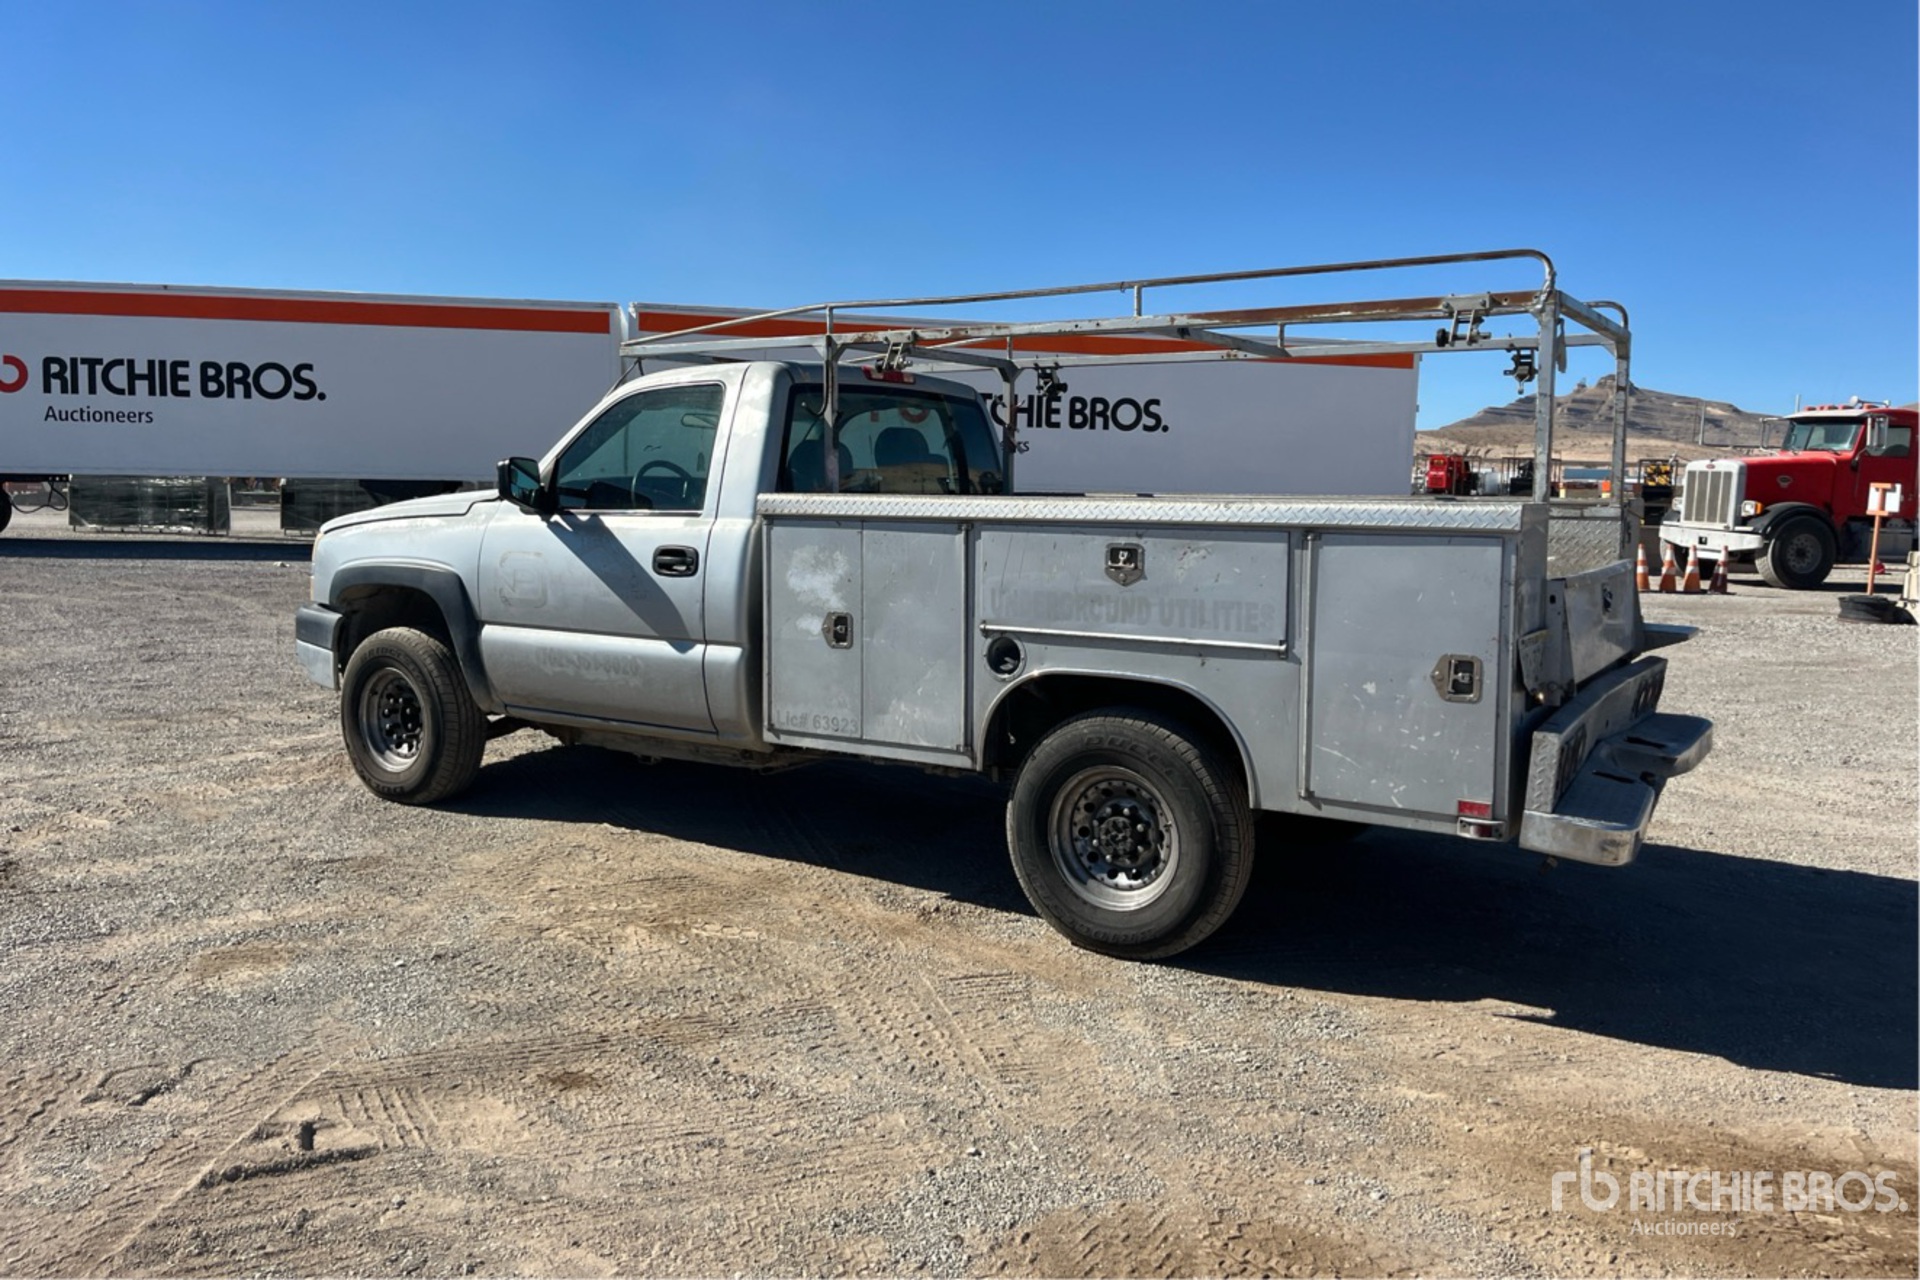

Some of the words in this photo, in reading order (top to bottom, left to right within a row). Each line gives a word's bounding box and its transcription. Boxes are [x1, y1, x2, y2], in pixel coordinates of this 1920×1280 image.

[43, 356, 191, 398] RITCHIE
[199, 360, 327, 401] BROS.
[44, 405, 154, 424] Auctioneers
[1068, 396, 1170, 433] BROS.
[1158, 596, 1276, 633] UTILITIES
[812, 713, 859, 735] 63923
